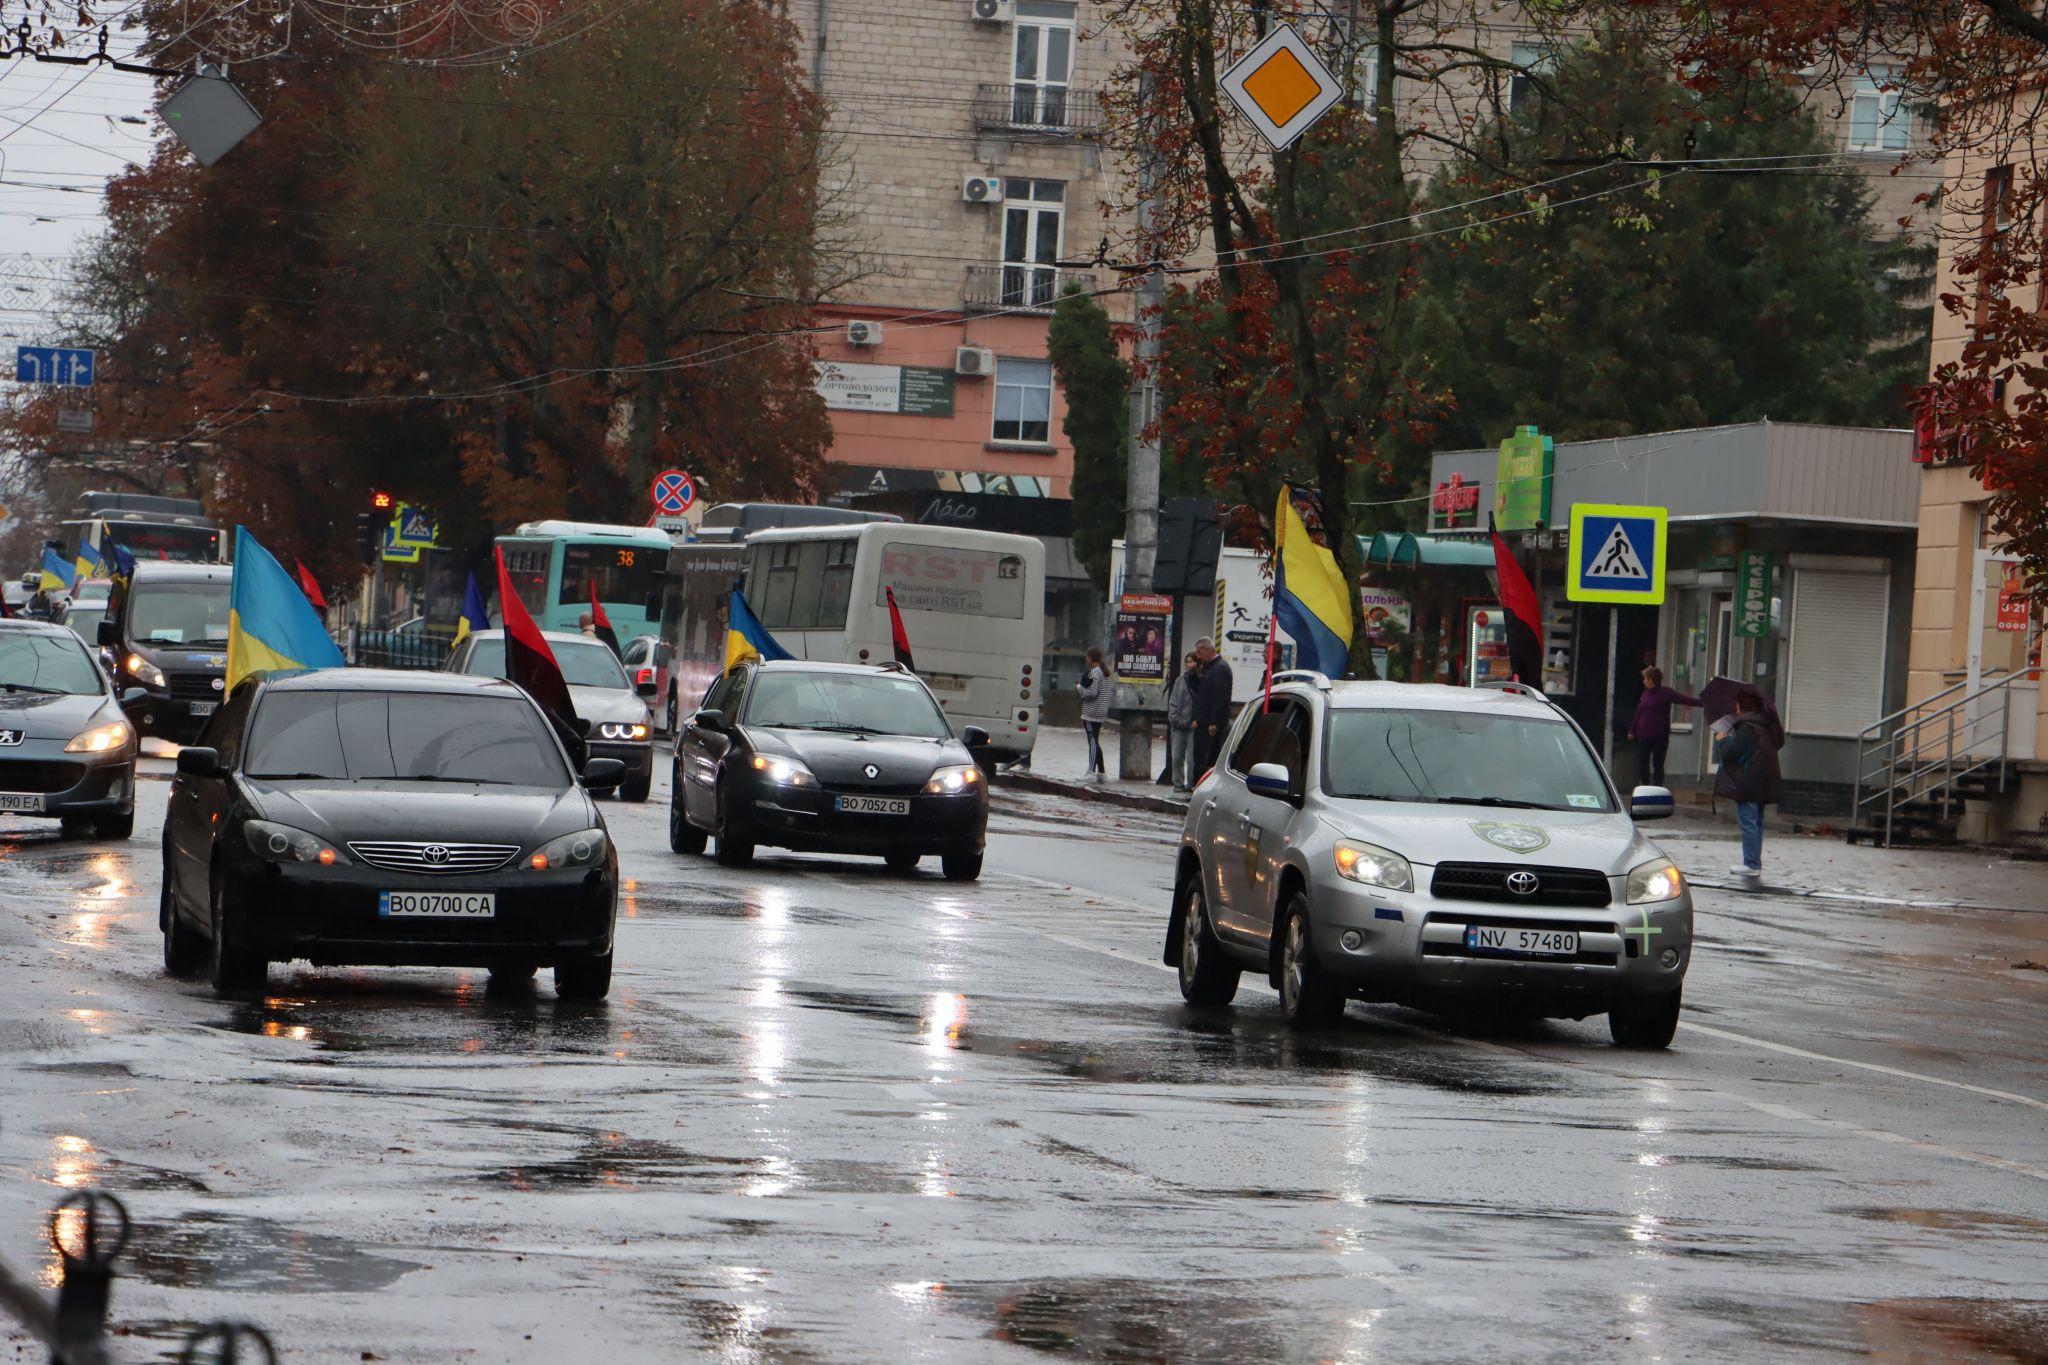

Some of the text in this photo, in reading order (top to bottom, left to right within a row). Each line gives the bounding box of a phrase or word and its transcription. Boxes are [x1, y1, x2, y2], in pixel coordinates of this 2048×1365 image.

[616, 550, 634, 567] 38
[883, 551, 997, 584] RST
[1232, 632, 1263, 641] Укриття
[23, 796, 40, 809] EA
[841, 797, 858, 809] BO
[860, 799, 887, 812] 7052
[889, 801, 906, 813] CB
[390, 895, 491, 914] BO 0700 CA
[1480, 929, 1574, 951] NV 57480
